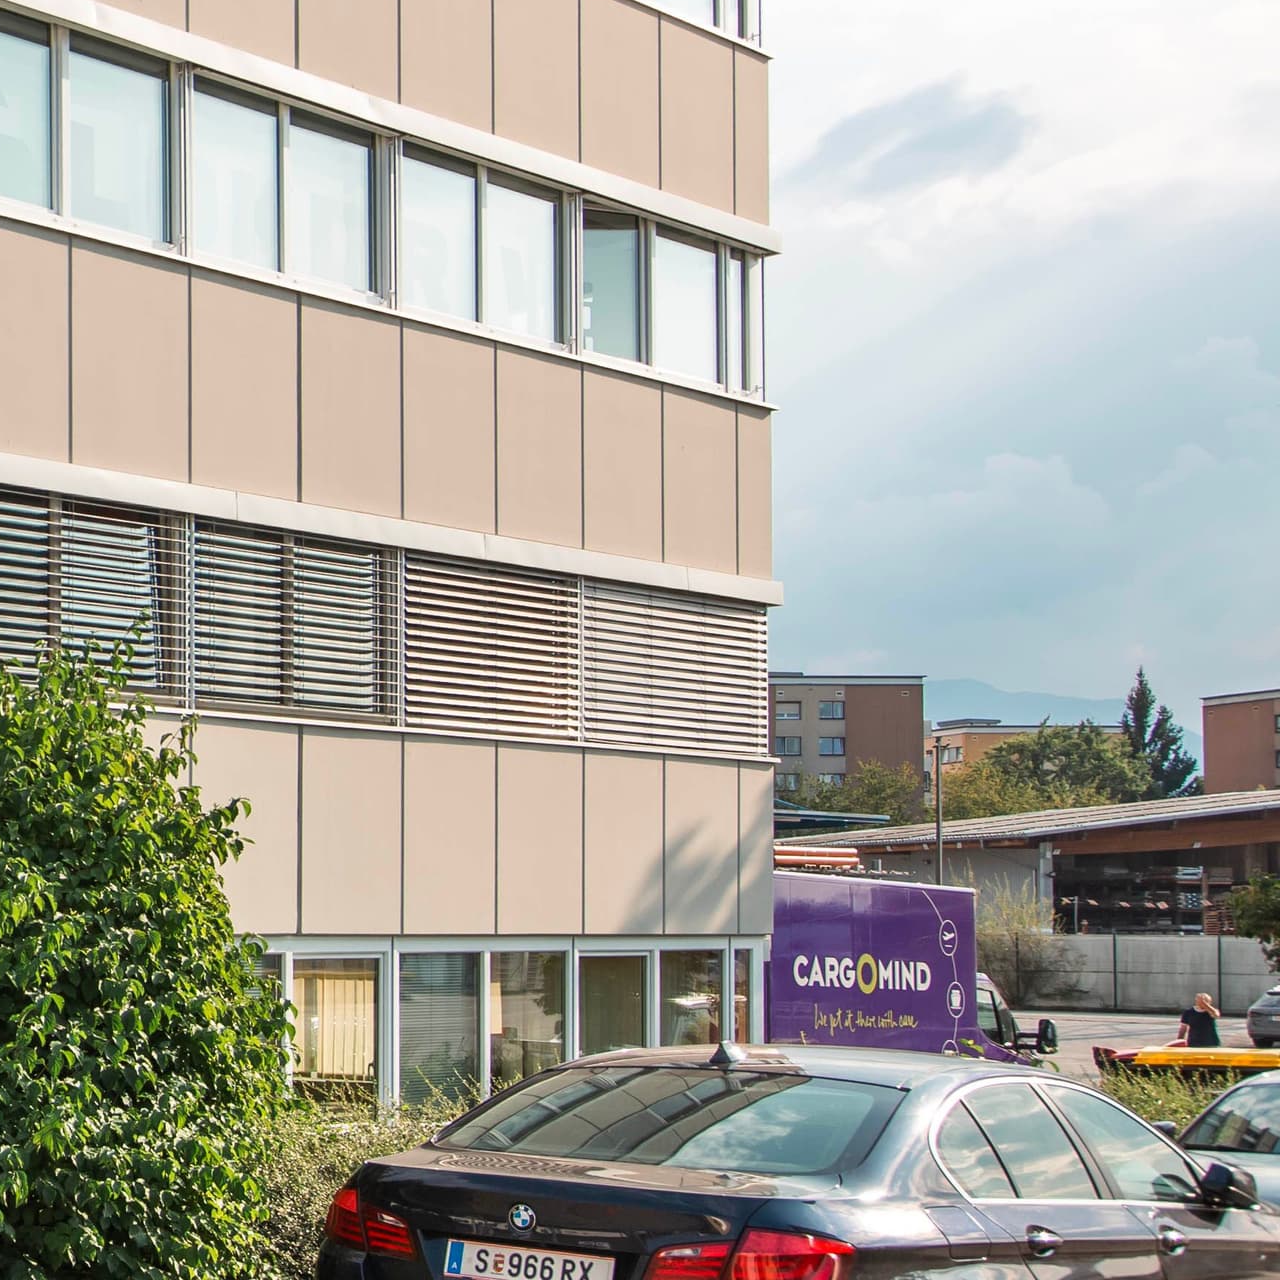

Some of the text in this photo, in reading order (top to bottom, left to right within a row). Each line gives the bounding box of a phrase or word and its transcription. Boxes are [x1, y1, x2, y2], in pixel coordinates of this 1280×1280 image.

[793, 953, 931, 994] CARGOMIND
[475, 1248, 490, 1274] S
[507, 1252, 556, 1280] 966
[561, 1258, 594, 1280] RX
